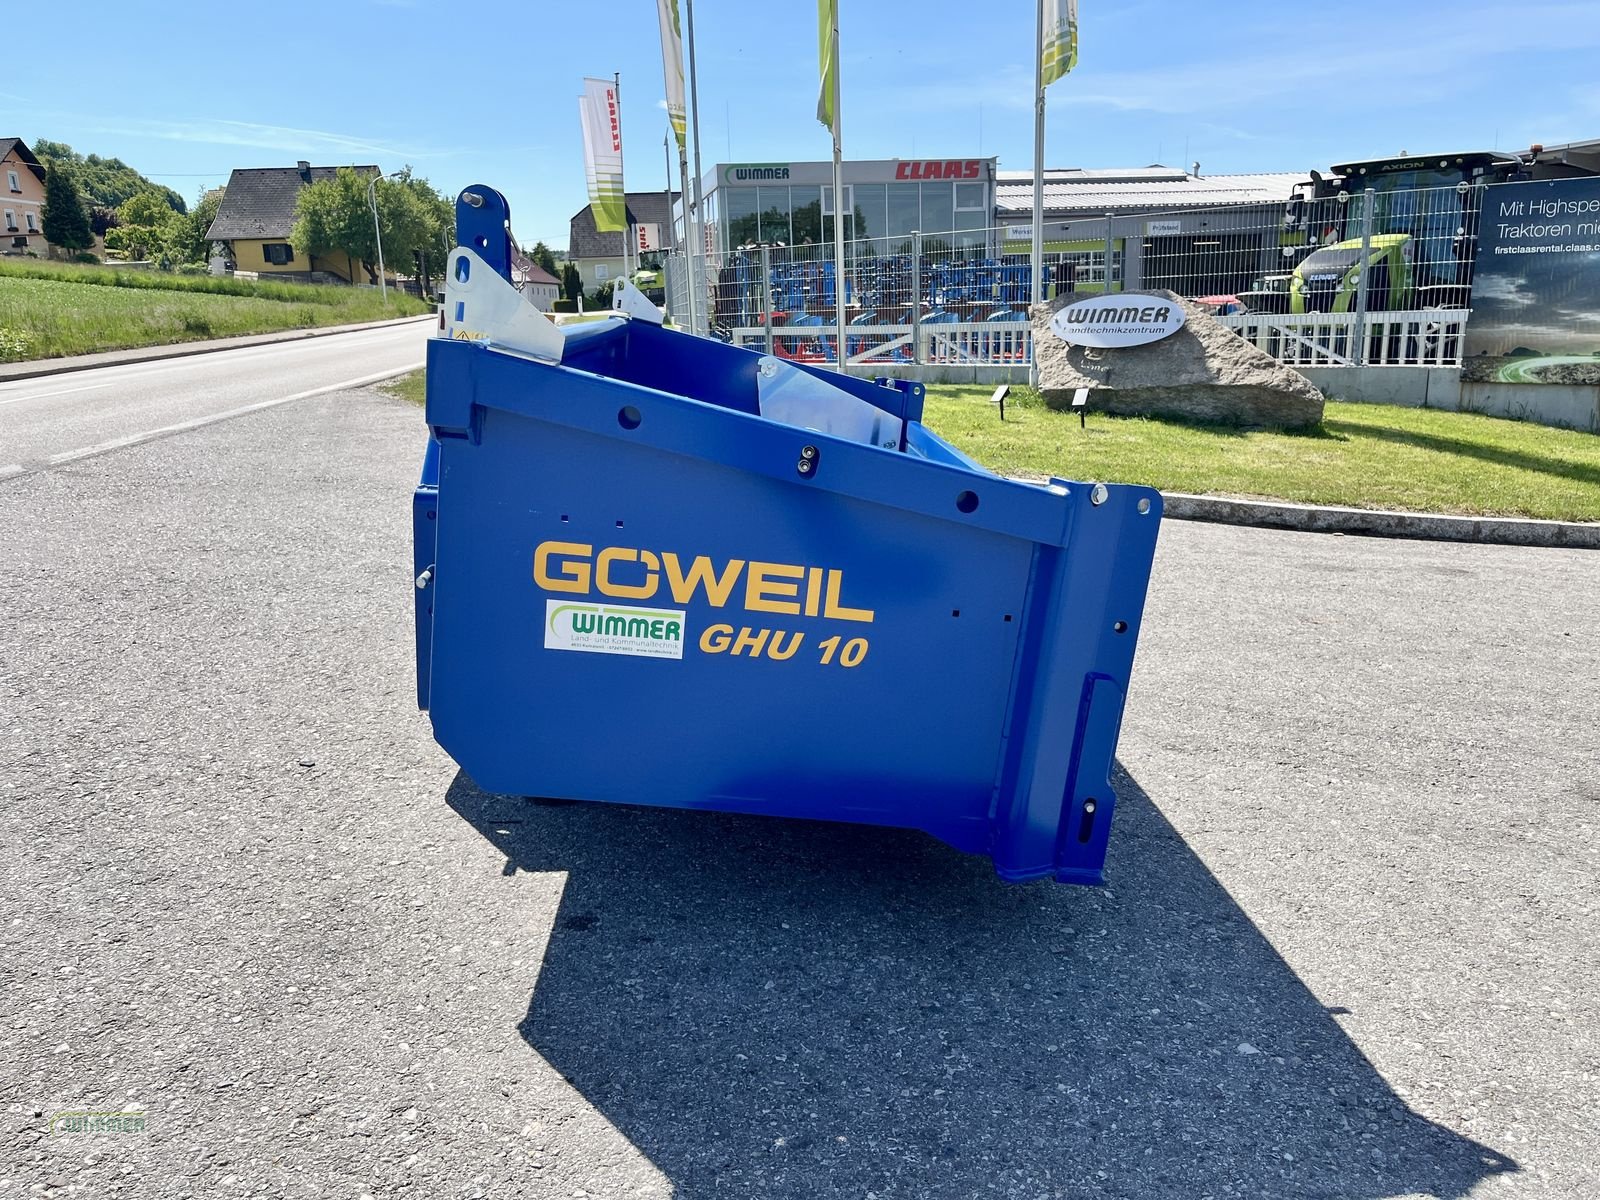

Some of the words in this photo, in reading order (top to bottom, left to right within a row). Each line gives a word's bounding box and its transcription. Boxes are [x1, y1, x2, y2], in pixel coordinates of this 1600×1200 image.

[736, 168, 790, 180] WIMMER
[895, 160, 981, 180] CLAAS
[1381, 161, 1425, 172] AXION
[1499, 201, 1525, 217] Mit
[1529, 198, 1600, 218] Highspe
[1497, 223, 1572, 239] Traktoren
[1577, 219, 1600, 235] mi
[1066, 307, 1171, 324] WIMMER
[572, 613, 681, 641] WIMMER
[699, 624, 804, 660] GHU
[817, 636, 869, 667] 10
